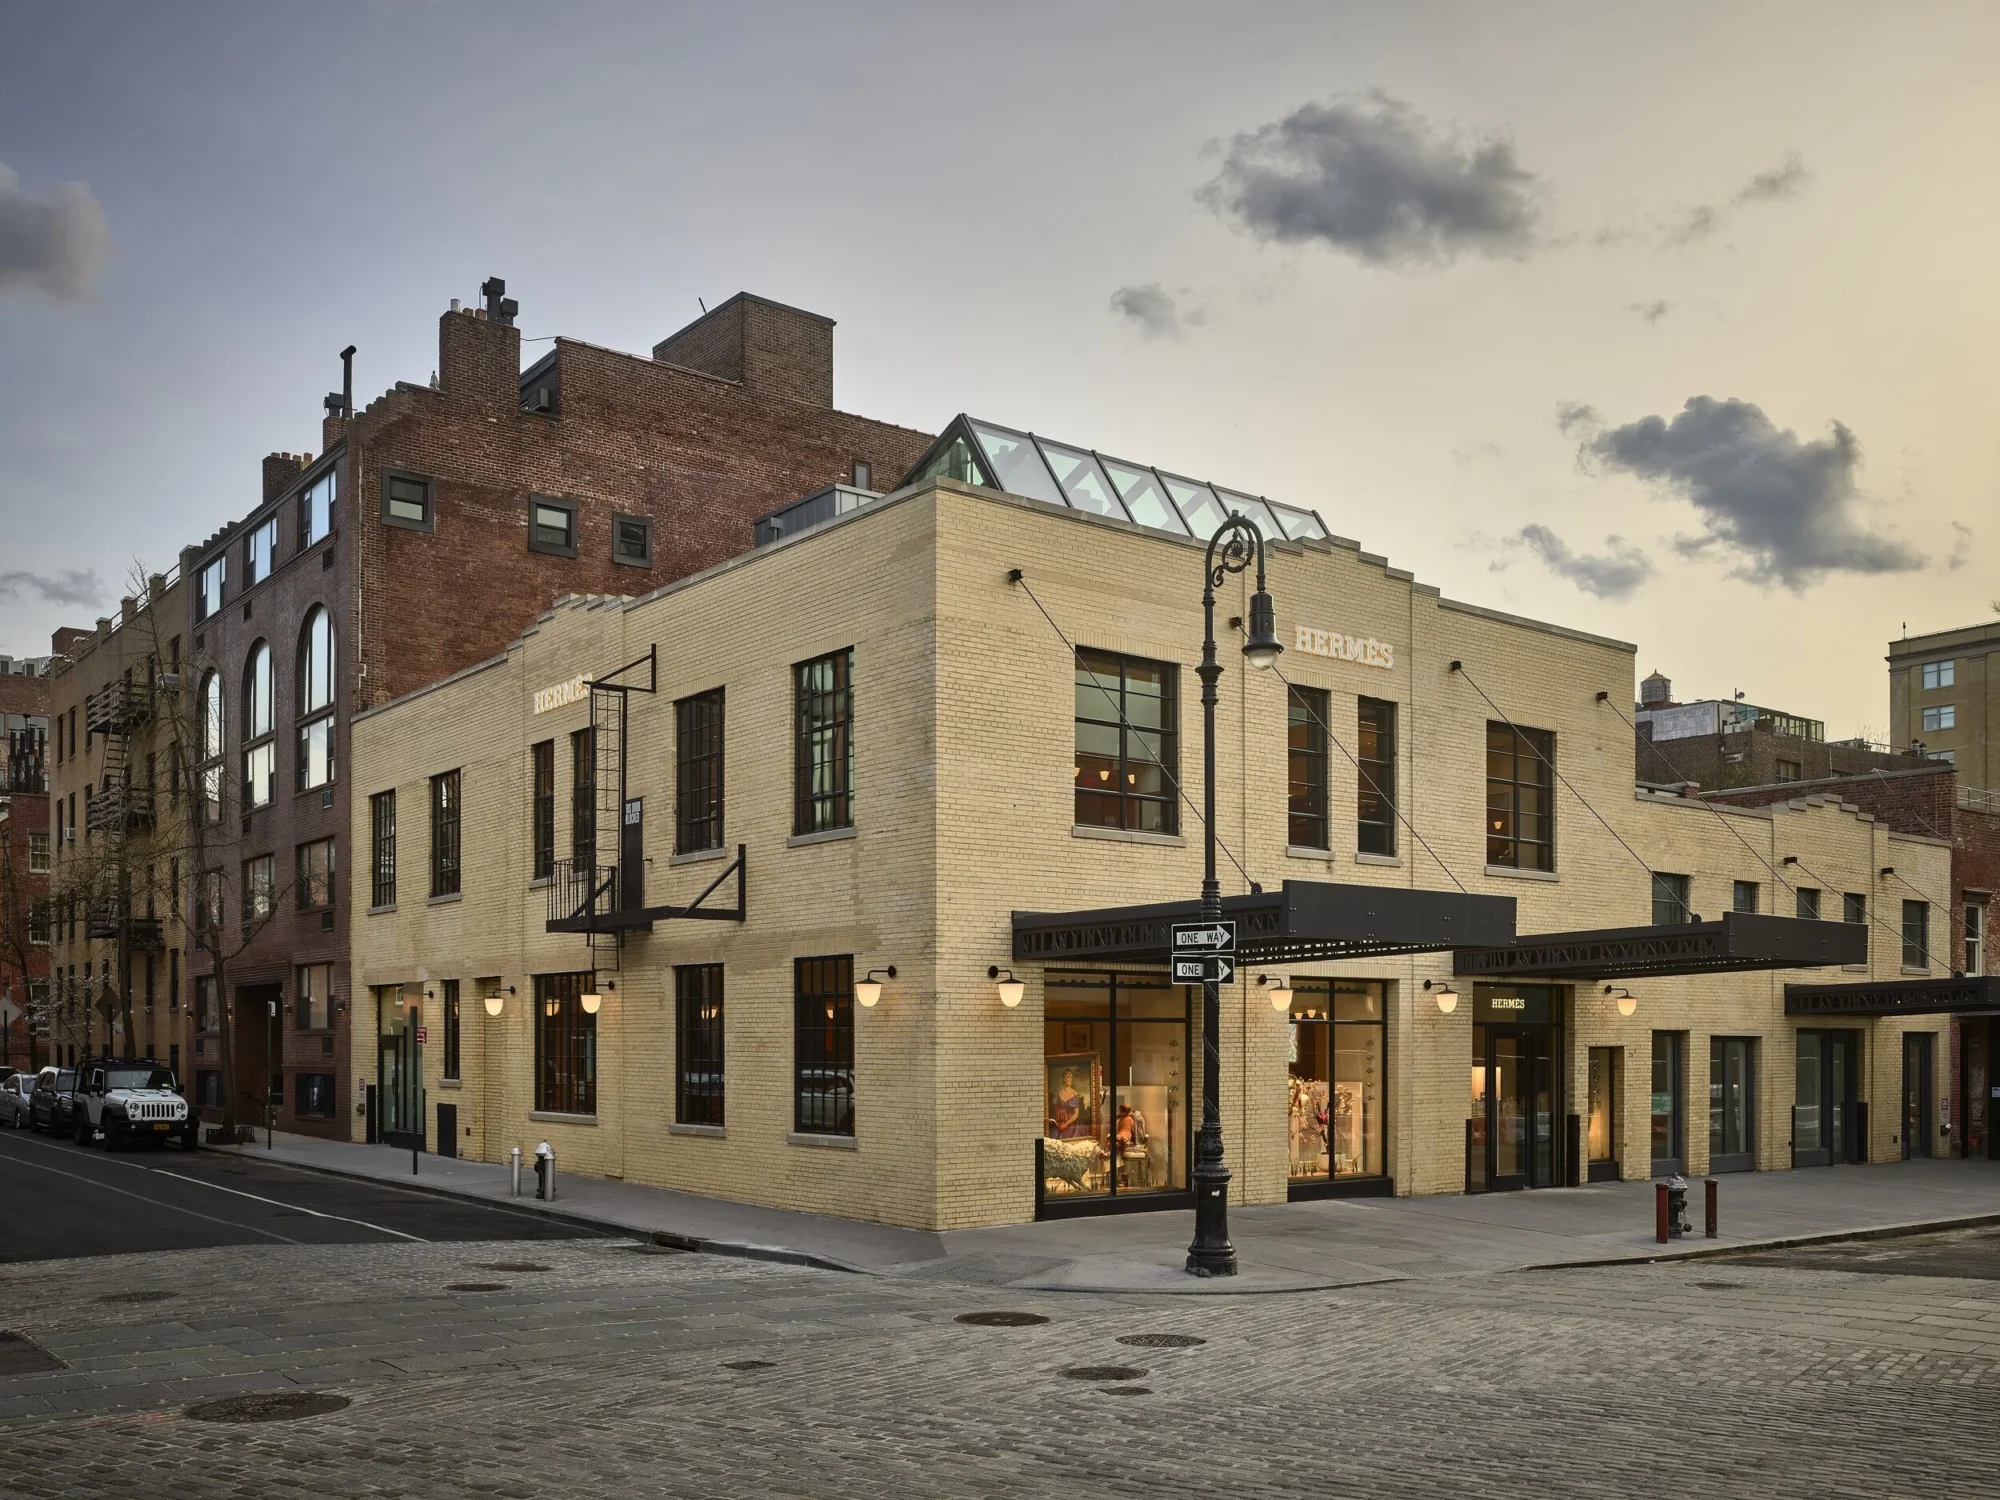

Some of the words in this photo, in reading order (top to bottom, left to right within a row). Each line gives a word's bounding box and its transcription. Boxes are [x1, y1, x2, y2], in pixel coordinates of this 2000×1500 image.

[1181, 932, 1199, 944] ONE
[1206, 931, 1225, 943] WAY
[1181, 964, 1200, 976] ONE
